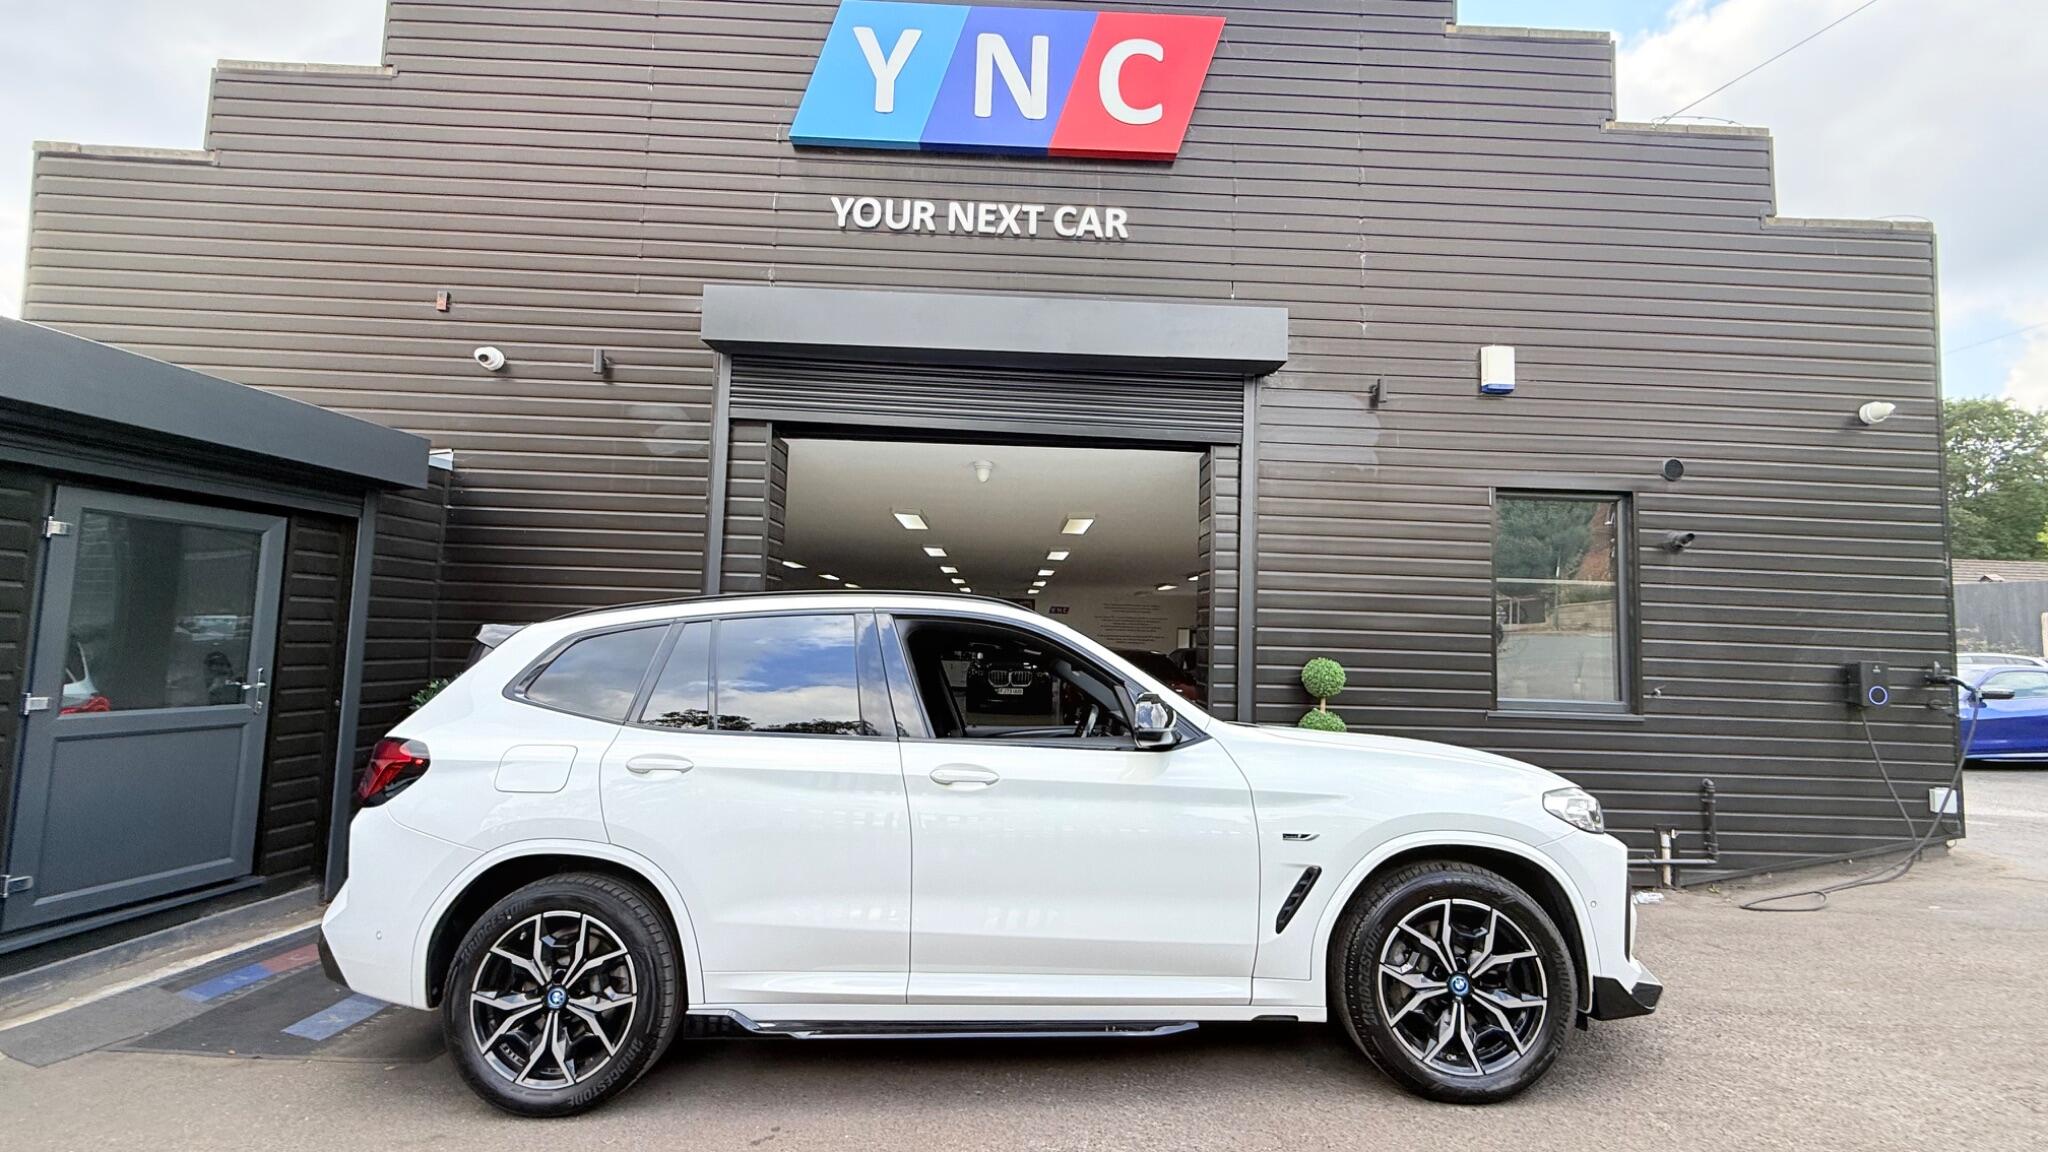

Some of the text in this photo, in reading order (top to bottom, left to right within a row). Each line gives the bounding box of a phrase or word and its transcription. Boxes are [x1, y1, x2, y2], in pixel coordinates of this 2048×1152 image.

[853, 26, 1164, 125] YNC
[831, 197, 1129, 240] YOUR NEXT CAR
[1358, 923, 1385, 1027] BRIDGESTONE
[567, 1037, 644, 1106] BRIDGESTONE
